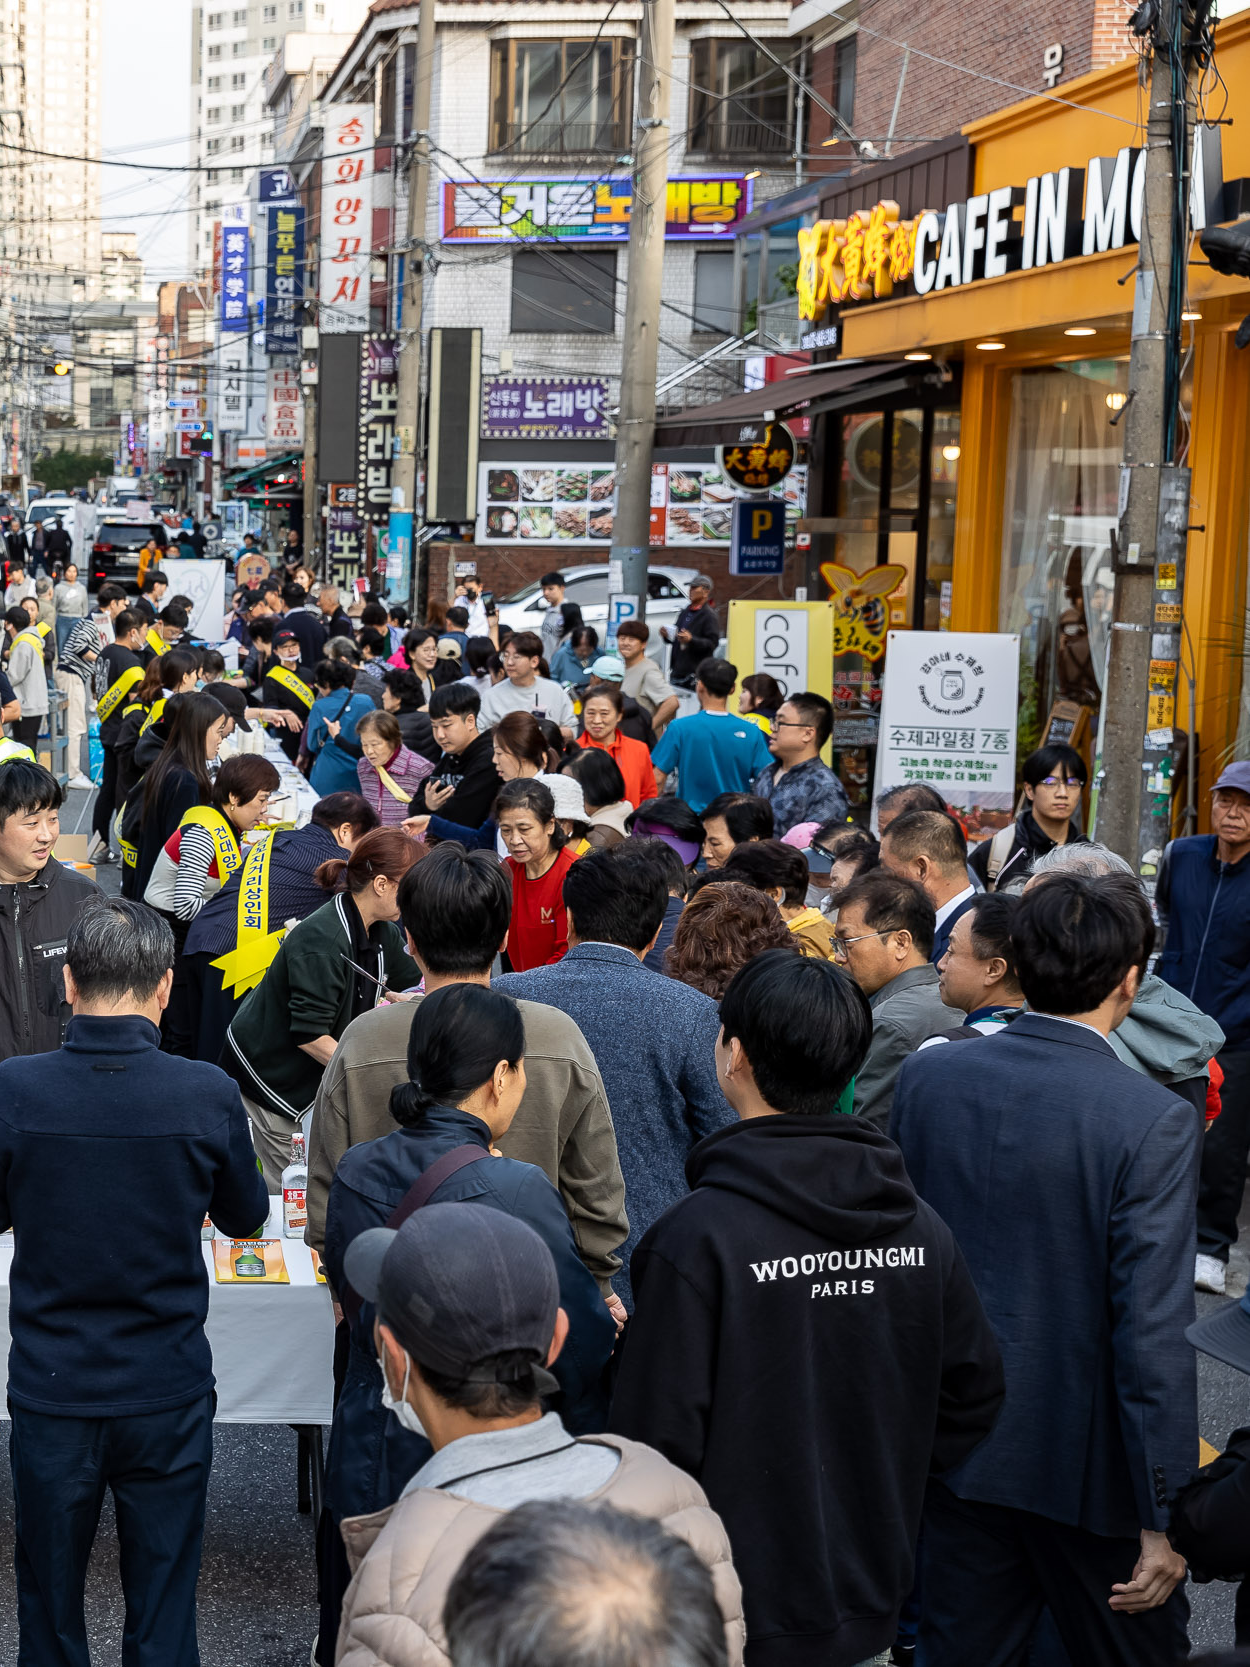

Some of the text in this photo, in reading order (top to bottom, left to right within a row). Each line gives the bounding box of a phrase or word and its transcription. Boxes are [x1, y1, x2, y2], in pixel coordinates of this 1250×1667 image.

[913, 186, 1013, 295] CAFE
[1021, 166, 1072, 270] IN
[274, 371, 298, 438] 中國食品
[523, 387, 605, 423] 노래방
[752, 509, 773, 540] P
[740, 545, 780, 557] PARKING
[616, 601, 636, 623] P
[890, 729, 1009, 751] 수제과일청 7종
[214, 825, 238, 877] 건대양
[749, 1247, 926, 1283] WOOYOUNGMI
[811, 1280, 875, 1299] PARIS
